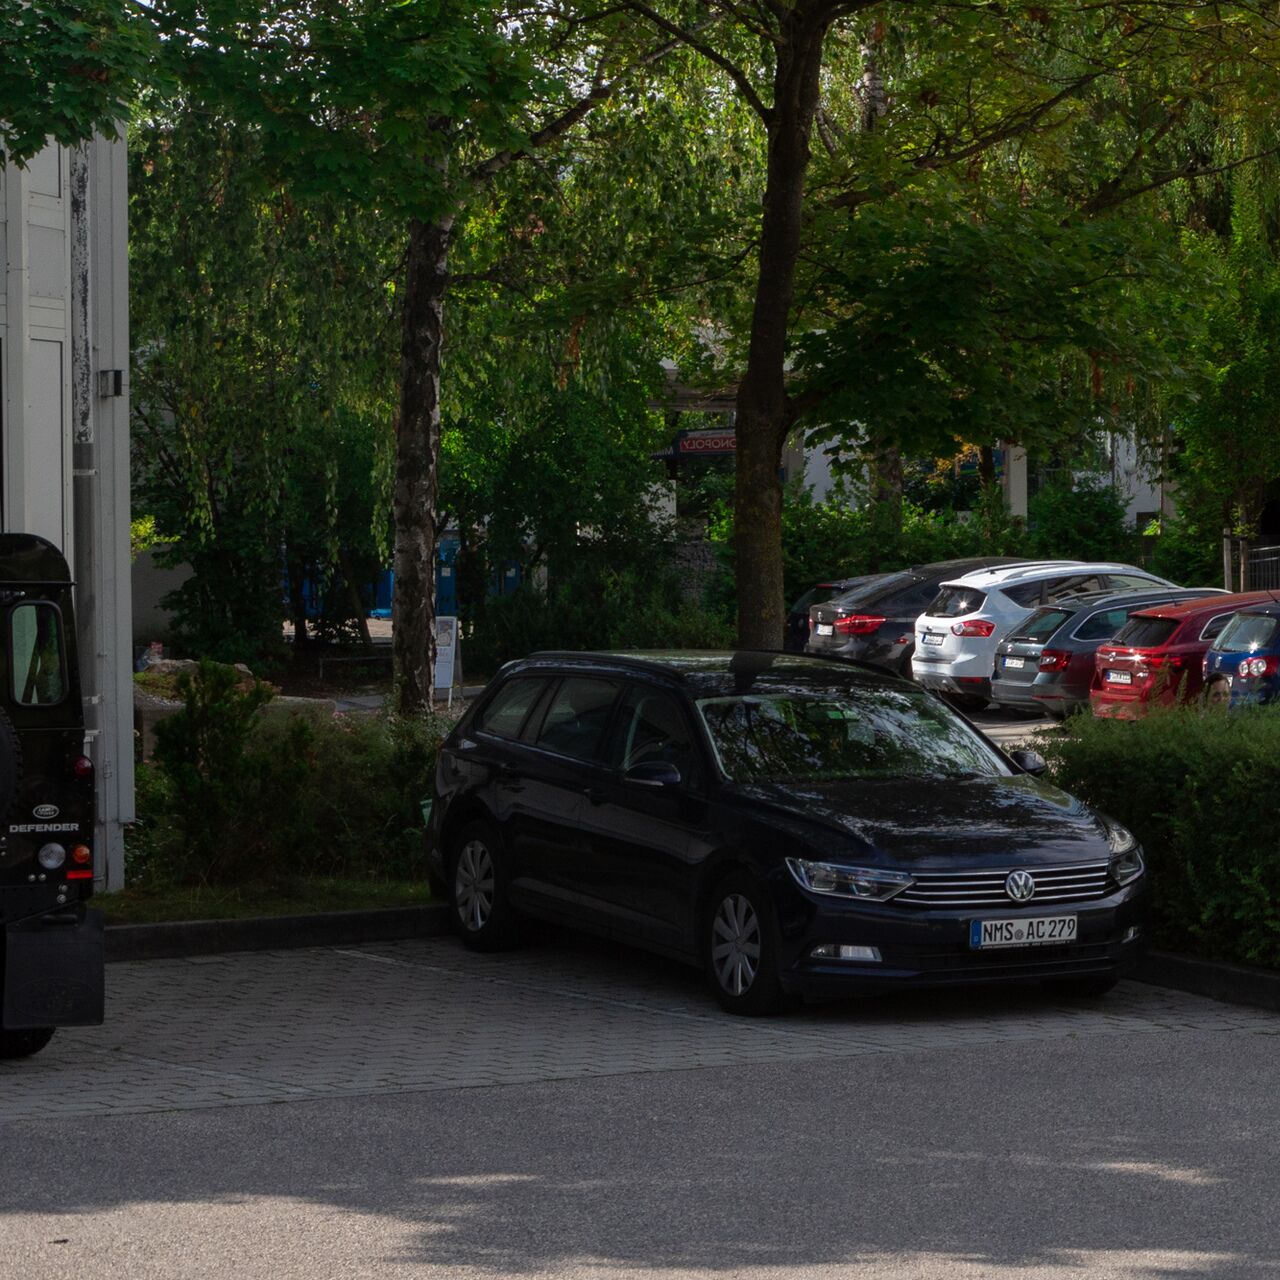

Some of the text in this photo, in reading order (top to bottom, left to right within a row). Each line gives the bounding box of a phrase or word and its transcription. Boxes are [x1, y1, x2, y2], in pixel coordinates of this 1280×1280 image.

[9, 823, 80, 833] DEFENDER
[983, 921, 1014, 942] NMS
[1026, 920, 1045, 940] AC
[1049, 918, 1076, 938] 279
